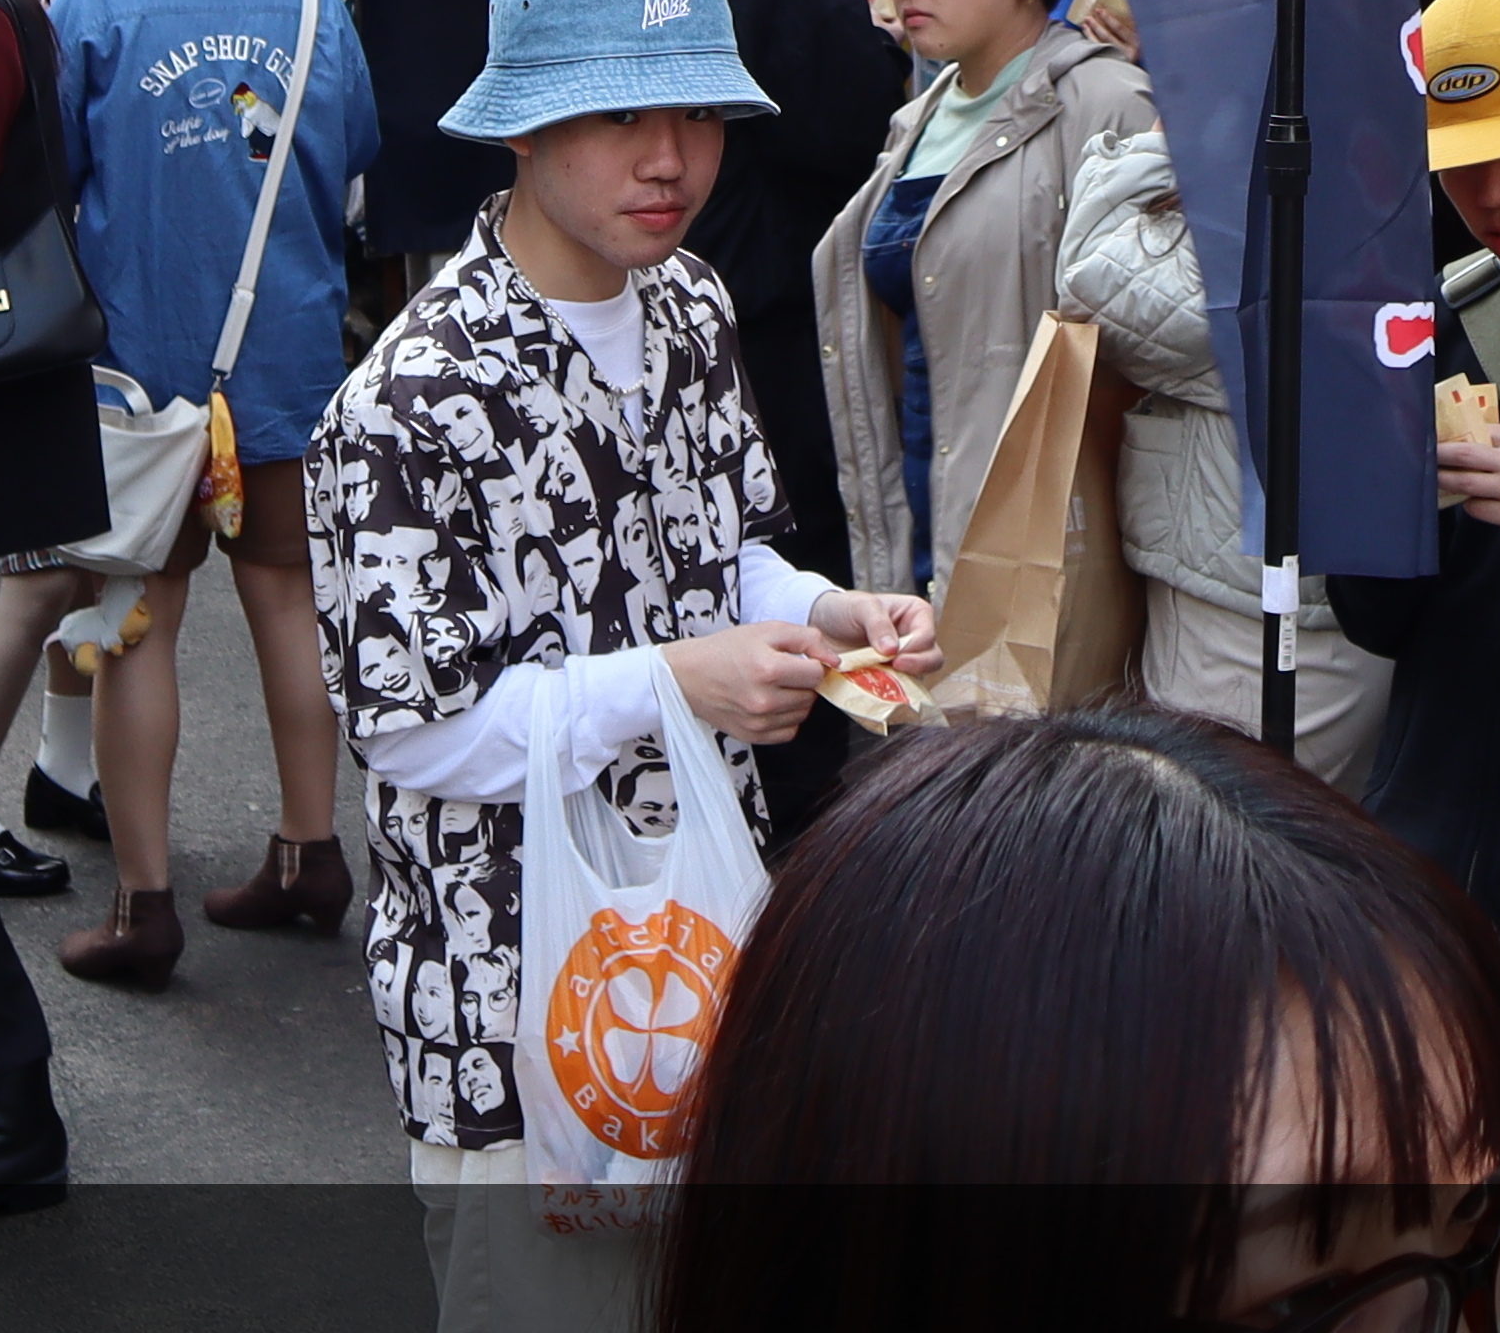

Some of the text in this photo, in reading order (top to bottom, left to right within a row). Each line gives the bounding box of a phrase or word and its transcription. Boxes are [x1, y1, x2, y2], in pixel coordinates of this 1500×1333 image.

[139, 40, 199, 98] SNAP
[202, 34, 267, 65] SHOT
[1437, 74, 1487, 93] ddp
[573, 1082, 662, 1152] Bak
